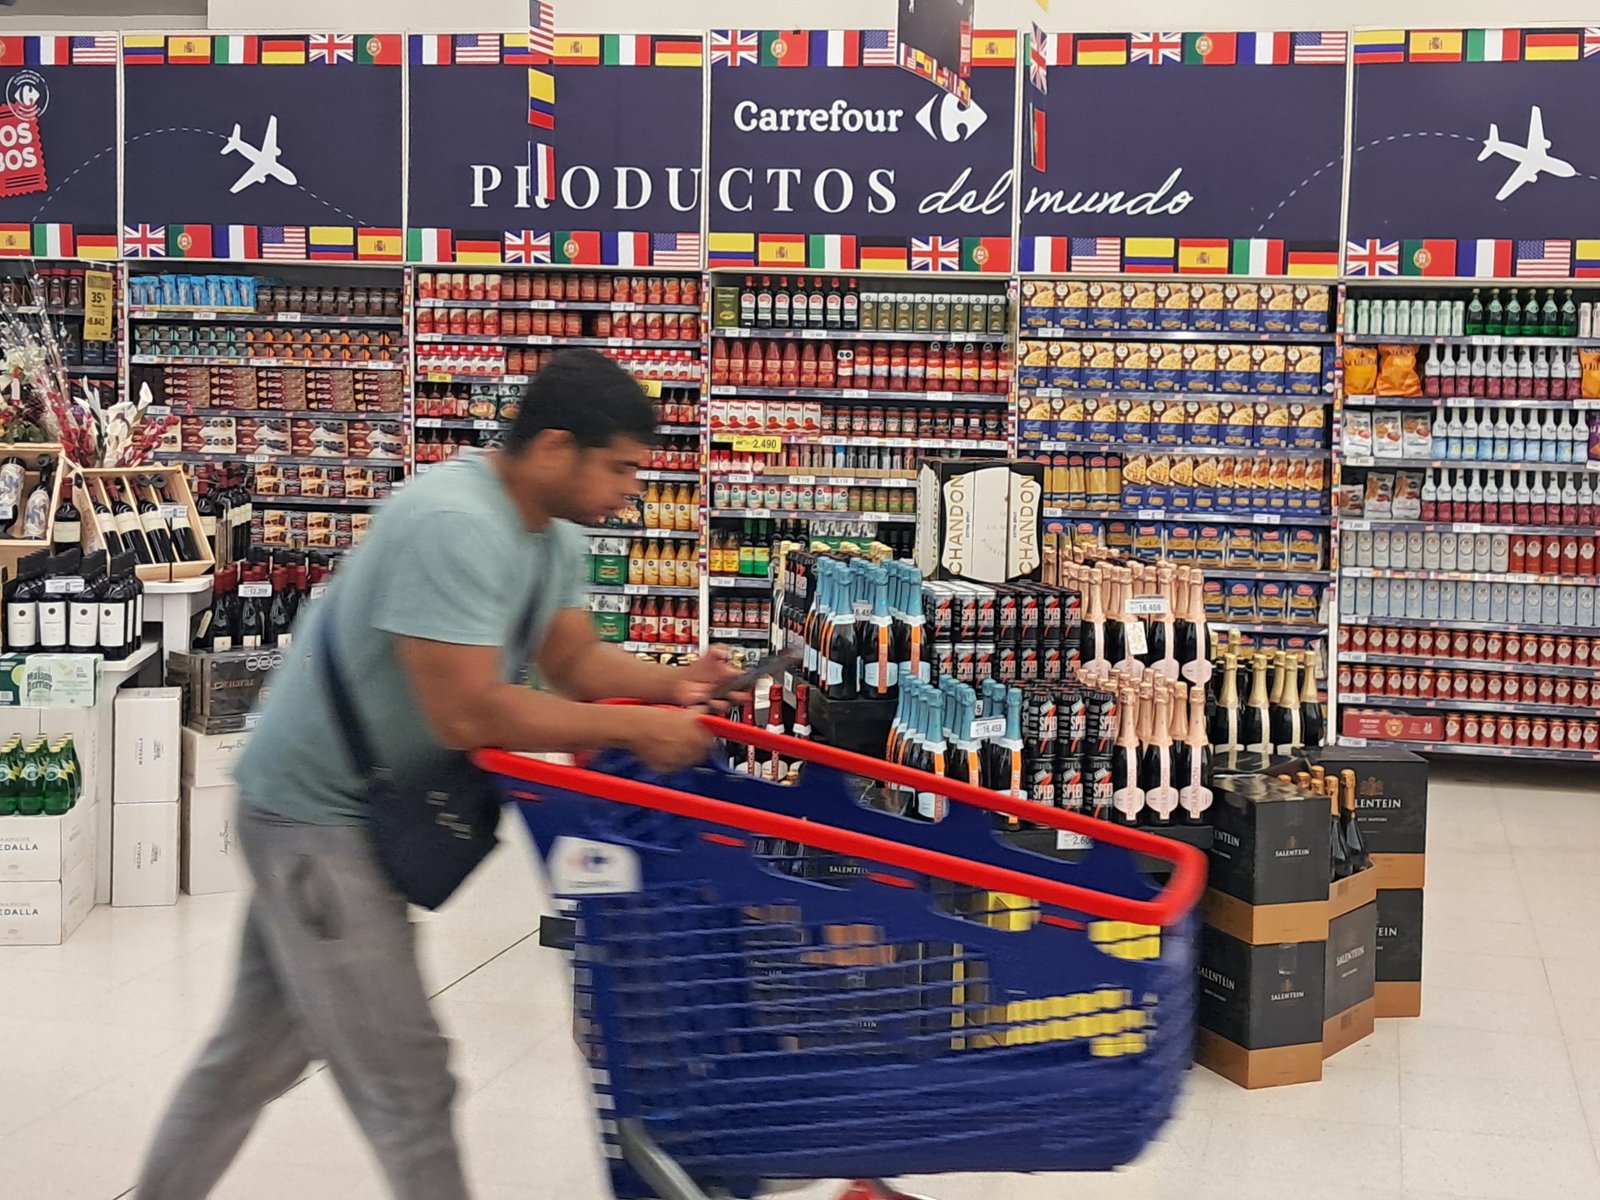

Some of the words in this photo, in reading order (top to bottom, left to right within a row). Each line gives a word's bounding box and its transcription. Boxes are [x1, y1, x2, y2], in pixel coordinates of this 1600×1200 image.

[734, 100, 903, 132] Carrefour
[470, 165, 896, 213] PRODUCTOS
[918, 167, 1014, 215] del
[1024, 167, 1194, 215] mundo
[752, 439, 777, 449] 2.490
[949, 475, 964, 575] CHANDON
[1019, 475, 1034, 575] CHANDON
[27, 671, 52, 682] Maison
[1275, 848, 1310, 857] SALENTEIN
[1271, 991, 1305, 1001] SALENTEIN
